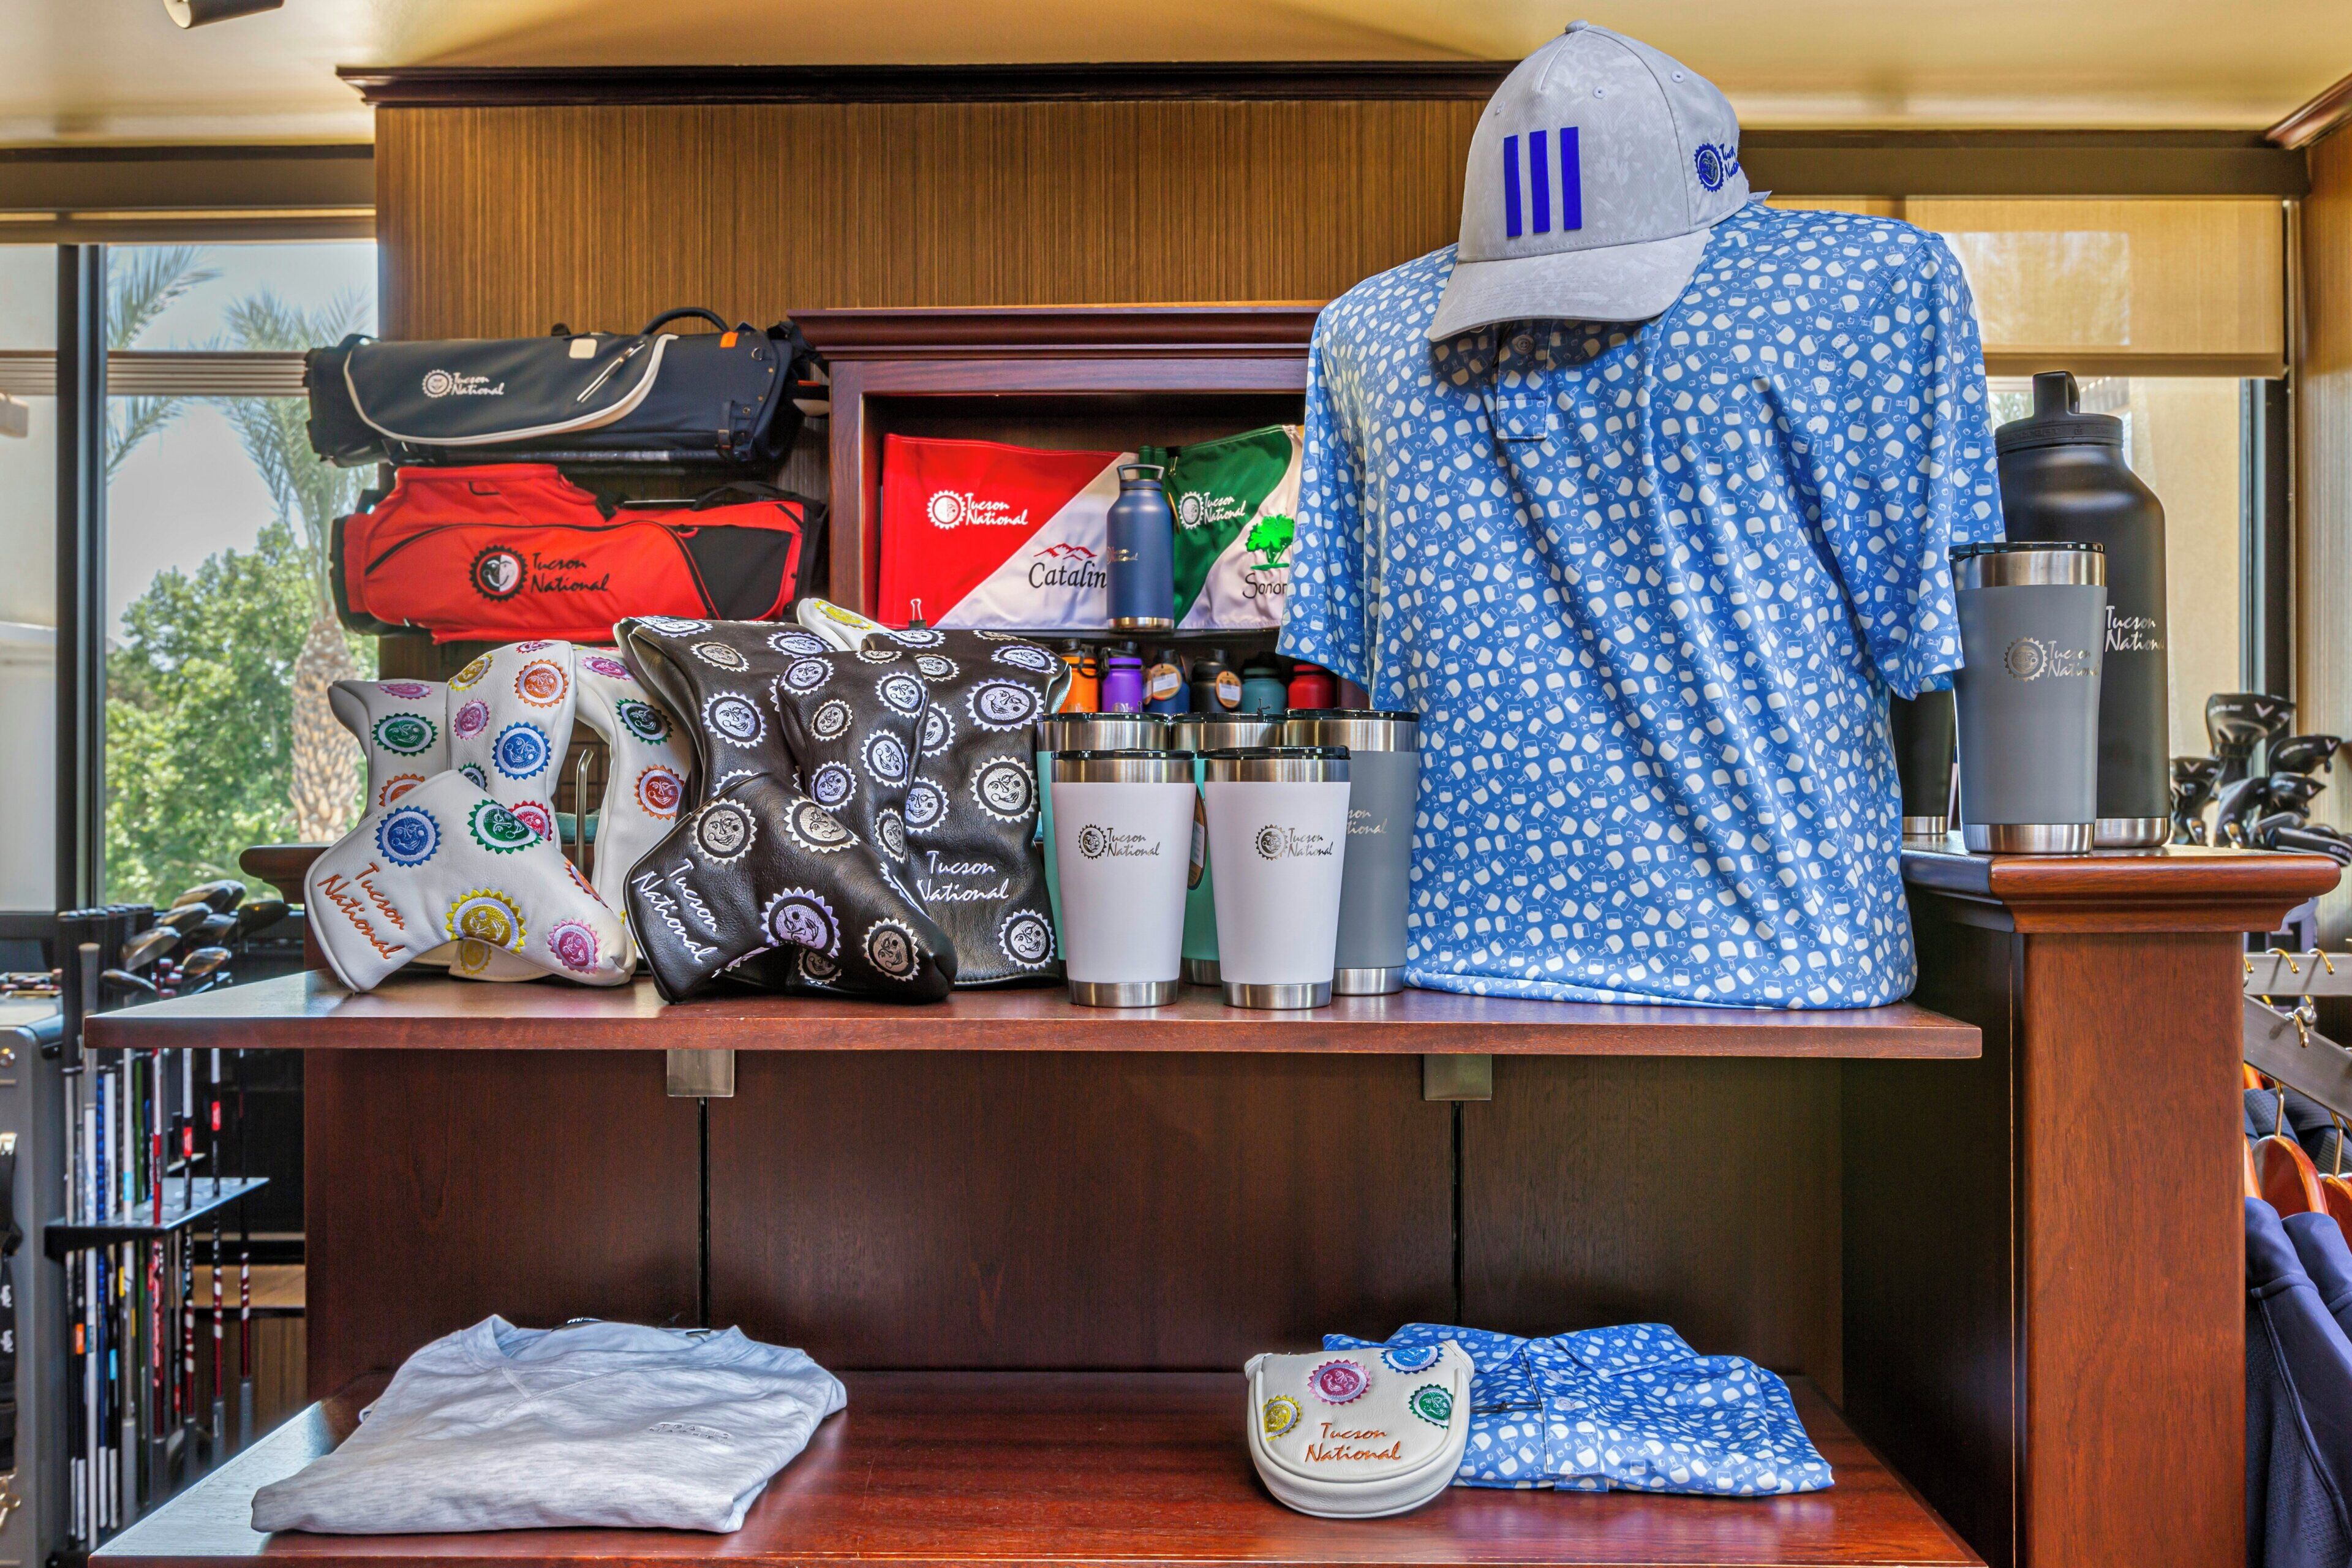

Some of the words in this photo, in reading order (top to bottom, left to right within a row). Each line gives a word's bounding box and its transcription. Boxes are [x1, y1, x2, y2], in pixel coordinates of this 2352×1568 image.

[451, 382, 505, 395] National
[964, 492, 1010, 510] Tucson
[1204, 492, 1235, 508] Tucson
[965, 508, 1028, 526] National
[1204, 500, 1246, 524] National
[532, 552, 587, 570] Tucson
[530, 573, 609, 593] National
[1028, 560, 1107, 589] Catalin
[1242, 572, 1287, 599] Sonor
[2106, 605, 2156, 630] Tucson
[2048, 640, 2090, 660] Tucson
[1107, 827, 1146, 843] Tucson
[1288, 827, 1324, 843] Tucson
[1347, 818, 1387, 834] tional
[1107, 842, 1161, 857] National
[1287, 842, 1333, 858] National
[926, 850, 996, 875] Tucson
[355, 862, 405, 930] Tucson
[669, 858, 717, 932] Tucson
[916, 878, 1009, 902] National
[317, 873, 405, 960] National
[631, 870, 718, 963] National
[1321, 1422, 1387, 1439] Tucson
[1305, 1440, 1401, 1463] National
